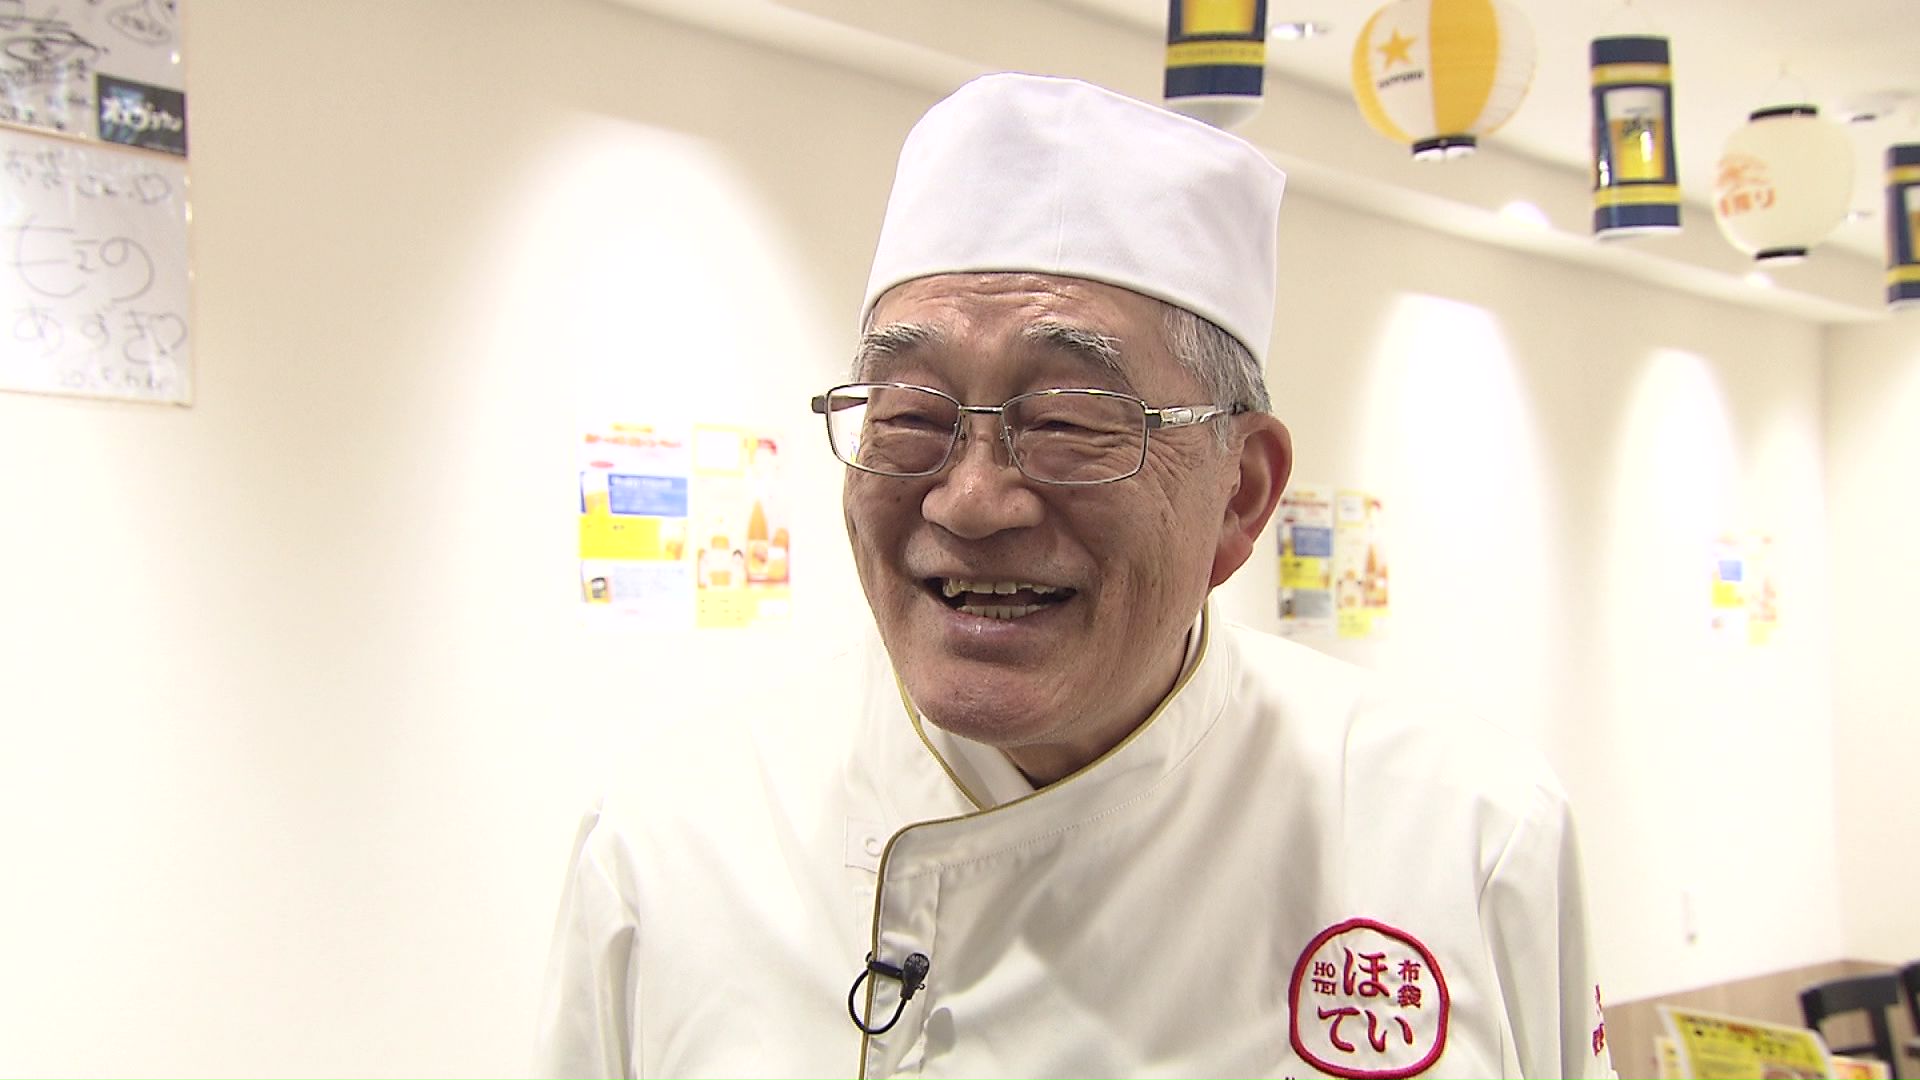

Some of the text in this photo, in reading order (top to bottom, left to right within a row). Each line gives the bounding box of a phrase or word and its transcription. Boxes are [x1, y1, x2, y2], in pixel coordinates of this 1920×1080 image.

[1314, 961, 1336, 978] HO
[1311, 979, 1336, 996] TEI
[1397, 959, 1422, 1009] 布袋
